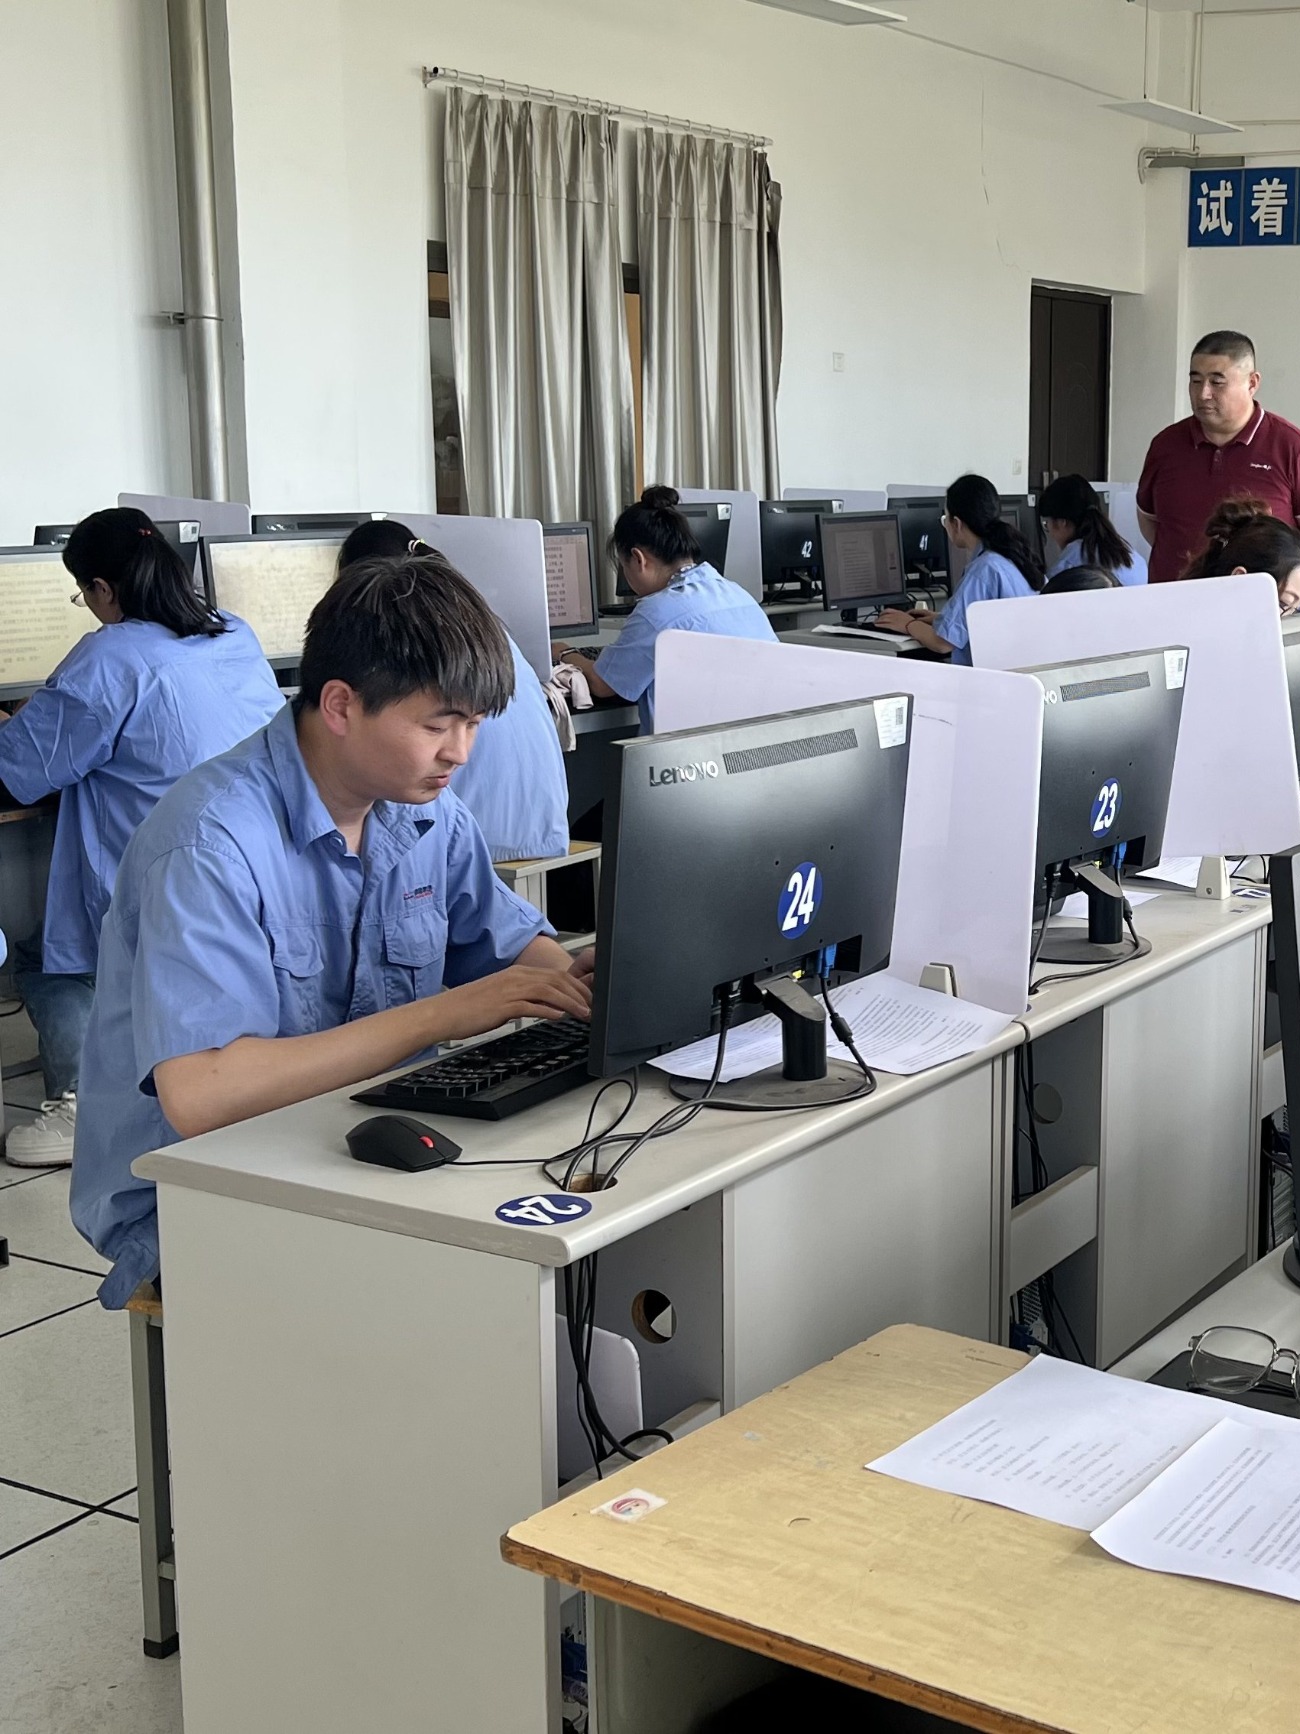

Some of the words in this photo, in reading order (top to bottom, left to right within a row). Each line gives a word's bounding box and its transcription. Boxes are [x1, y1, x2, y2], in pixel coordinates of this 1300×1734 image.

[801, 541, 813, 558] 42
[649, 760, 719, 787] Lenovo
[1093, 782, 1119, 832] 23
[781, 866, 817, 932] 24
[500, 1195, 583, 1225] 24
